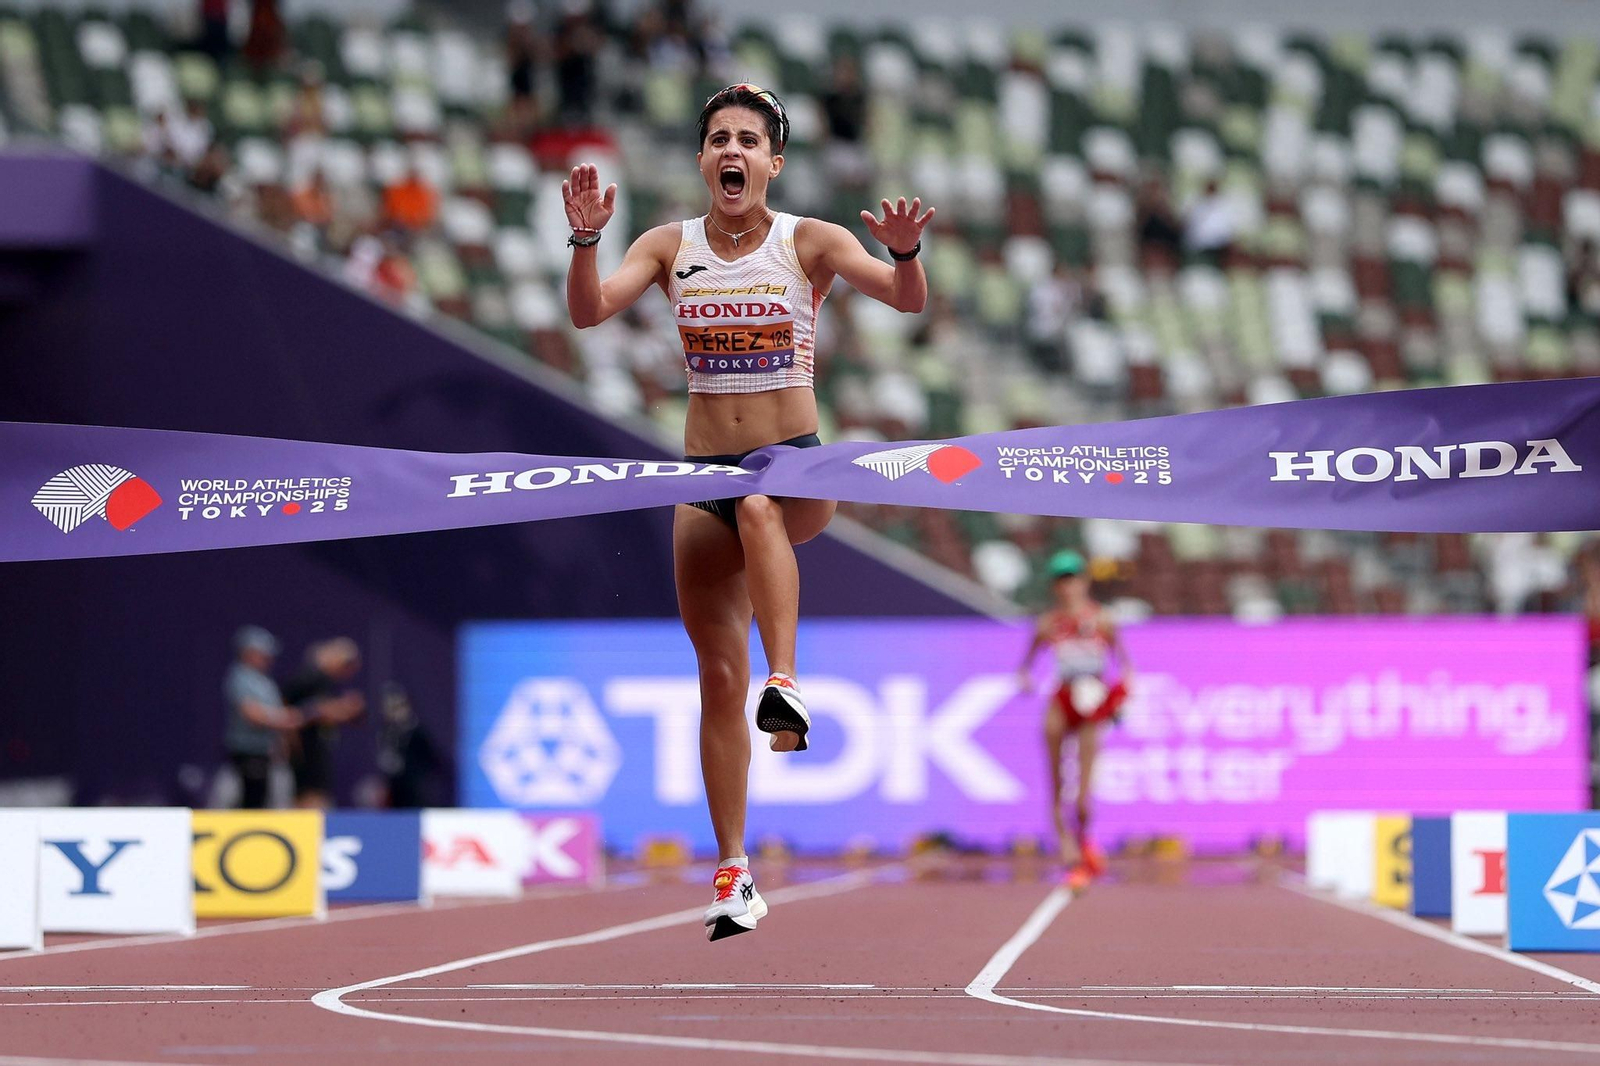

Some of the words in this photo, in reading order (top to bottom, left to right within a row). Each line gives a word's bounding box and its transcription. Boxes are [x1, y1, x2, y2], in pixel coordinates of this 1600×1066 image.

[678, 303, 790, 318] HONDA
[684, 328, 764, 352] PÉREZ
[770, 329, 791, 348] 126
[997, 446, 1054, 457] WORLD
[1060, 445, 1169, 459] ATHLETICS
[1268, 438, 1582, 482] HONDA
[997, 456, 1171, 472] CHAMPIONSHIPS
[180, 479, 248, 491] WORLD
[251, 477, 351, 490] ATHLETICS
[447, 462, 753, 498] HONDA
[1133, 471, 1173, 485] 25
[178, 488, 350, 506] CHAMPIONSHIPS
[310, 499, 349, 513] 25
[604, 674, 1027, 806] TDK
[43, 838, 142, 896] Y
